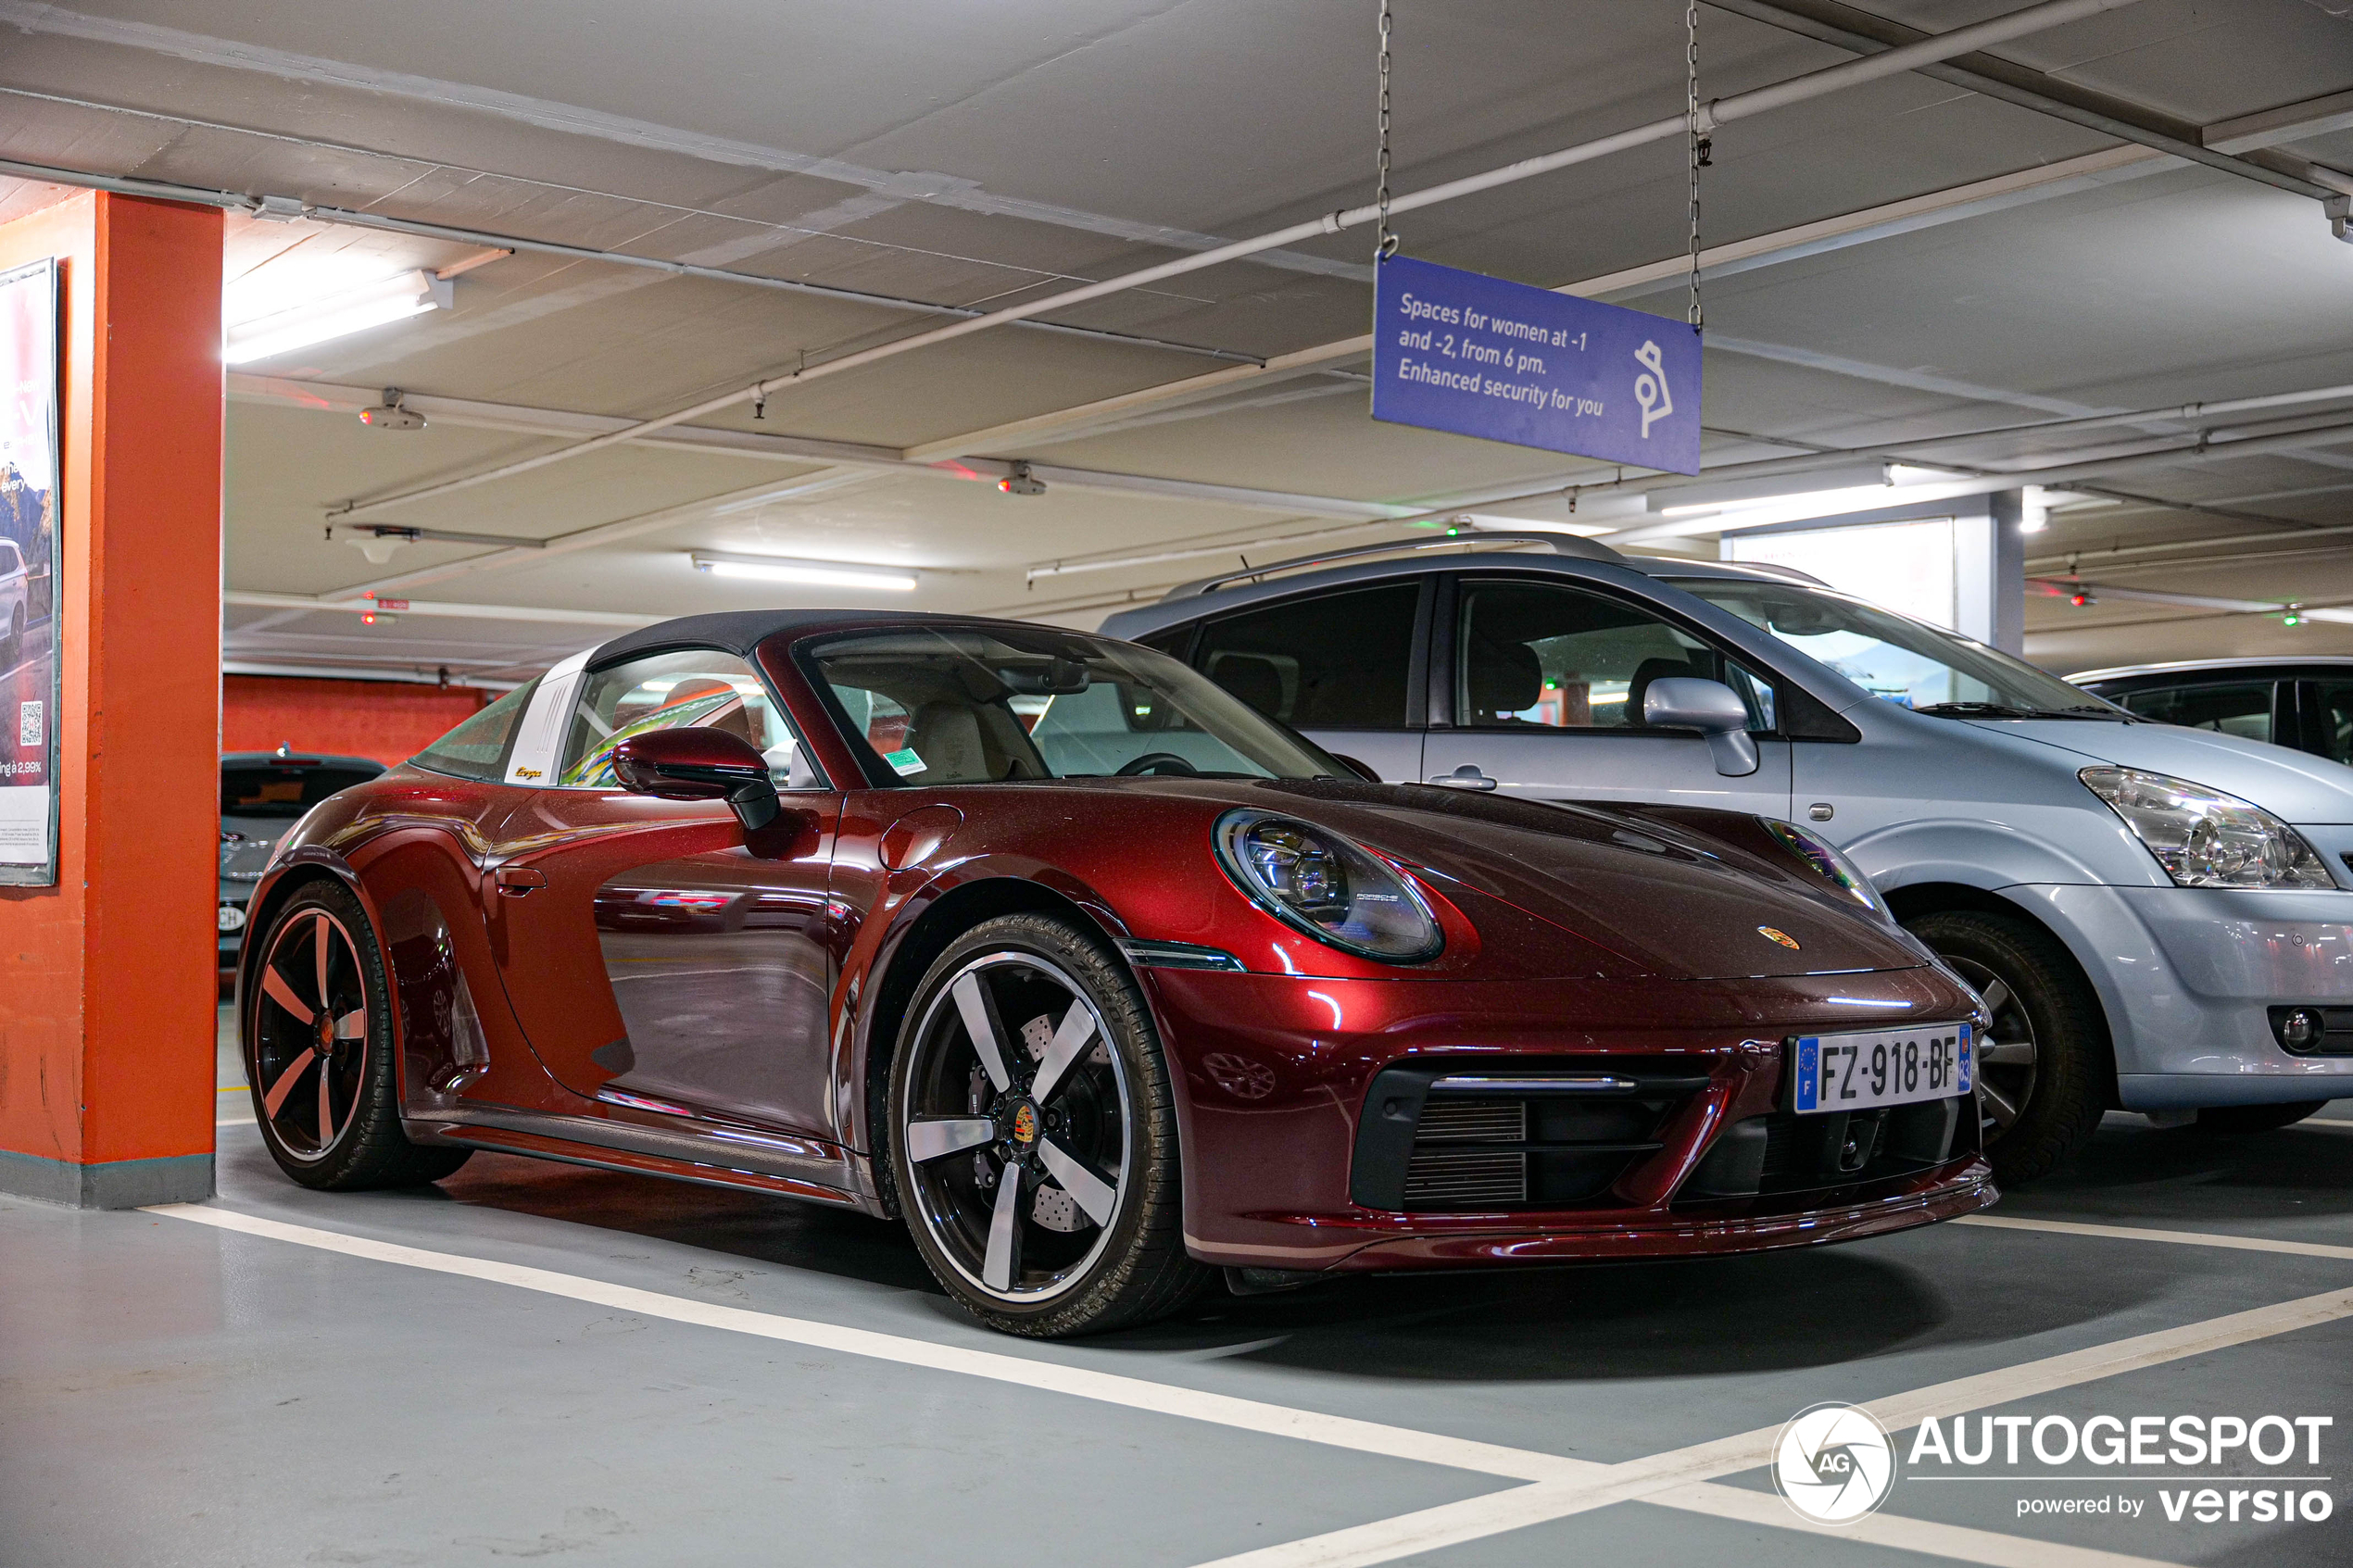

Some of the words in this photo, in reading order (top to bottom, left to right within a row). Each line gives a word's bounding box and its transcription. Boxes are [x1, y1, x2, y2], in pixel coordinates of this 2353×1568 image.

[1400, 293, 1460, 324] Spaces
[1464, 307, 1489, 330] for
[1491, 318, 1548, 344] women
[1551, 330, 1567, 347] at
[1571, 332, 1587, 351] -1
[1399, 330, 1432, 350] and
[1435, 333, 1457, 359] -2,
[1461, 338, 1501, 365] from
[1504, 347, 1514, 368] 6
[1516, 355, 1547, 374] pm.
[1398, 358, 1481, 393] Enhanced
[1483, 378, 1549, 409] security
[1551, 388, 1574, 409] for
[1576, 397, 1604, 418] you
[2, 479, 25, 493] every
[18, 761, 42, 775] 2,99%
[1820, 1035, 1957, 1101] FZ-918-BF
[1958, 1059, 1969, 1083] 83
[1804, 1080, 1811, 1096] F
